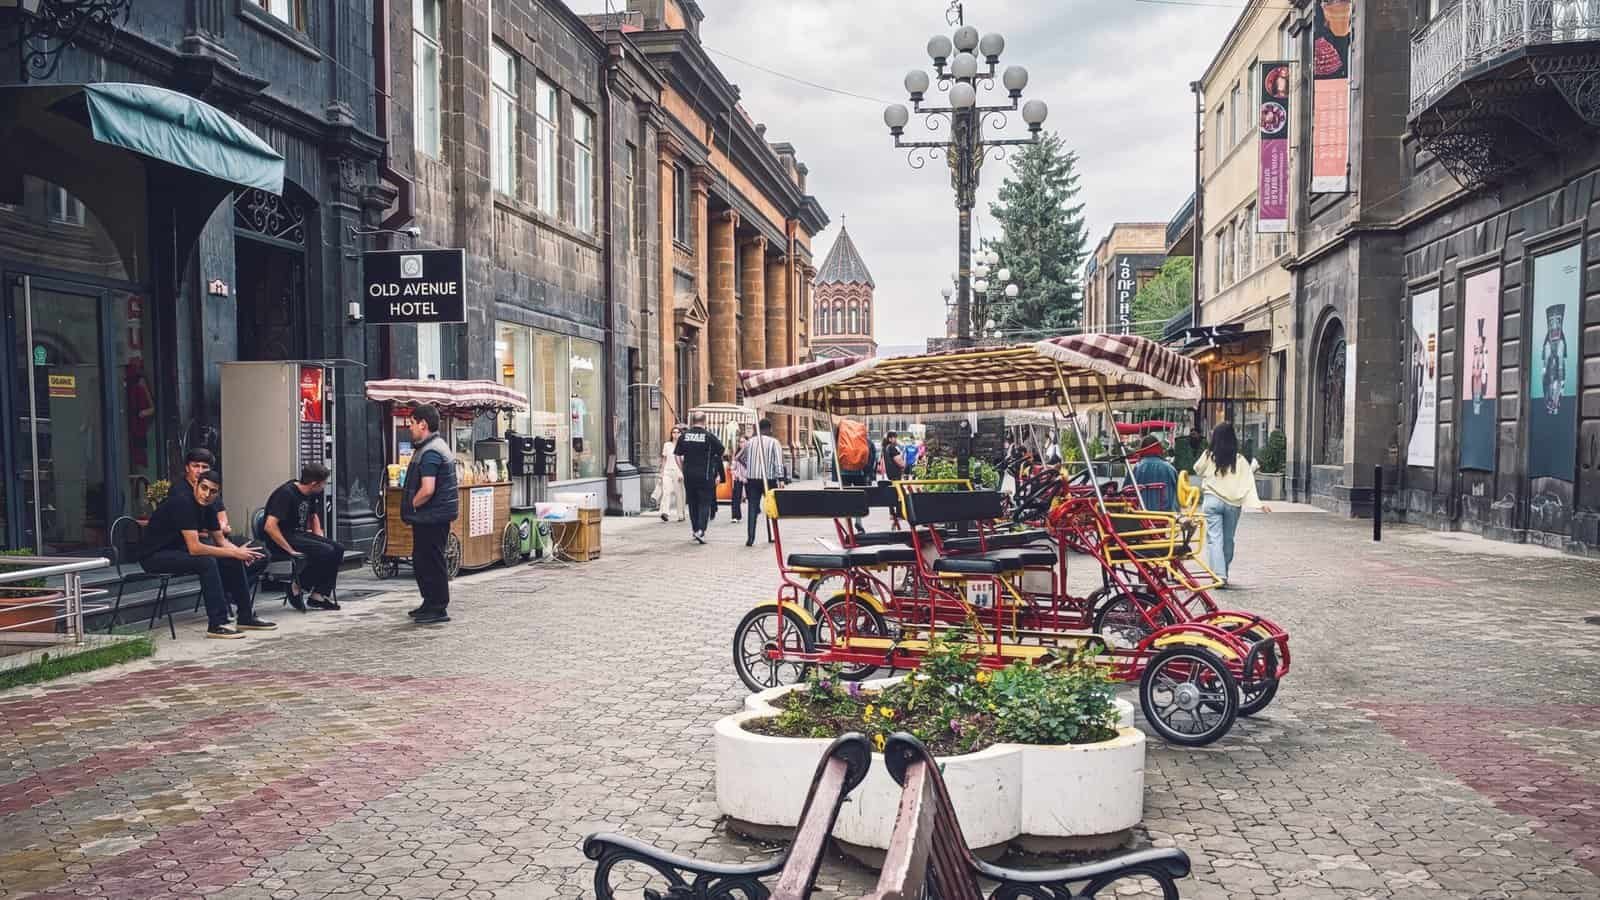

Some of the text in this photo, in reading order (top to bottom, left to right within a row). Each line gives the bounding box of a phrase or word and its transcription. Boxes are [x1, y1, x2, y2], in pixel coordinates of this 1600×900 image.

[370, 282, 457, 296] OLD AVENUE
[390, 302, 439, 316] HOTEL
